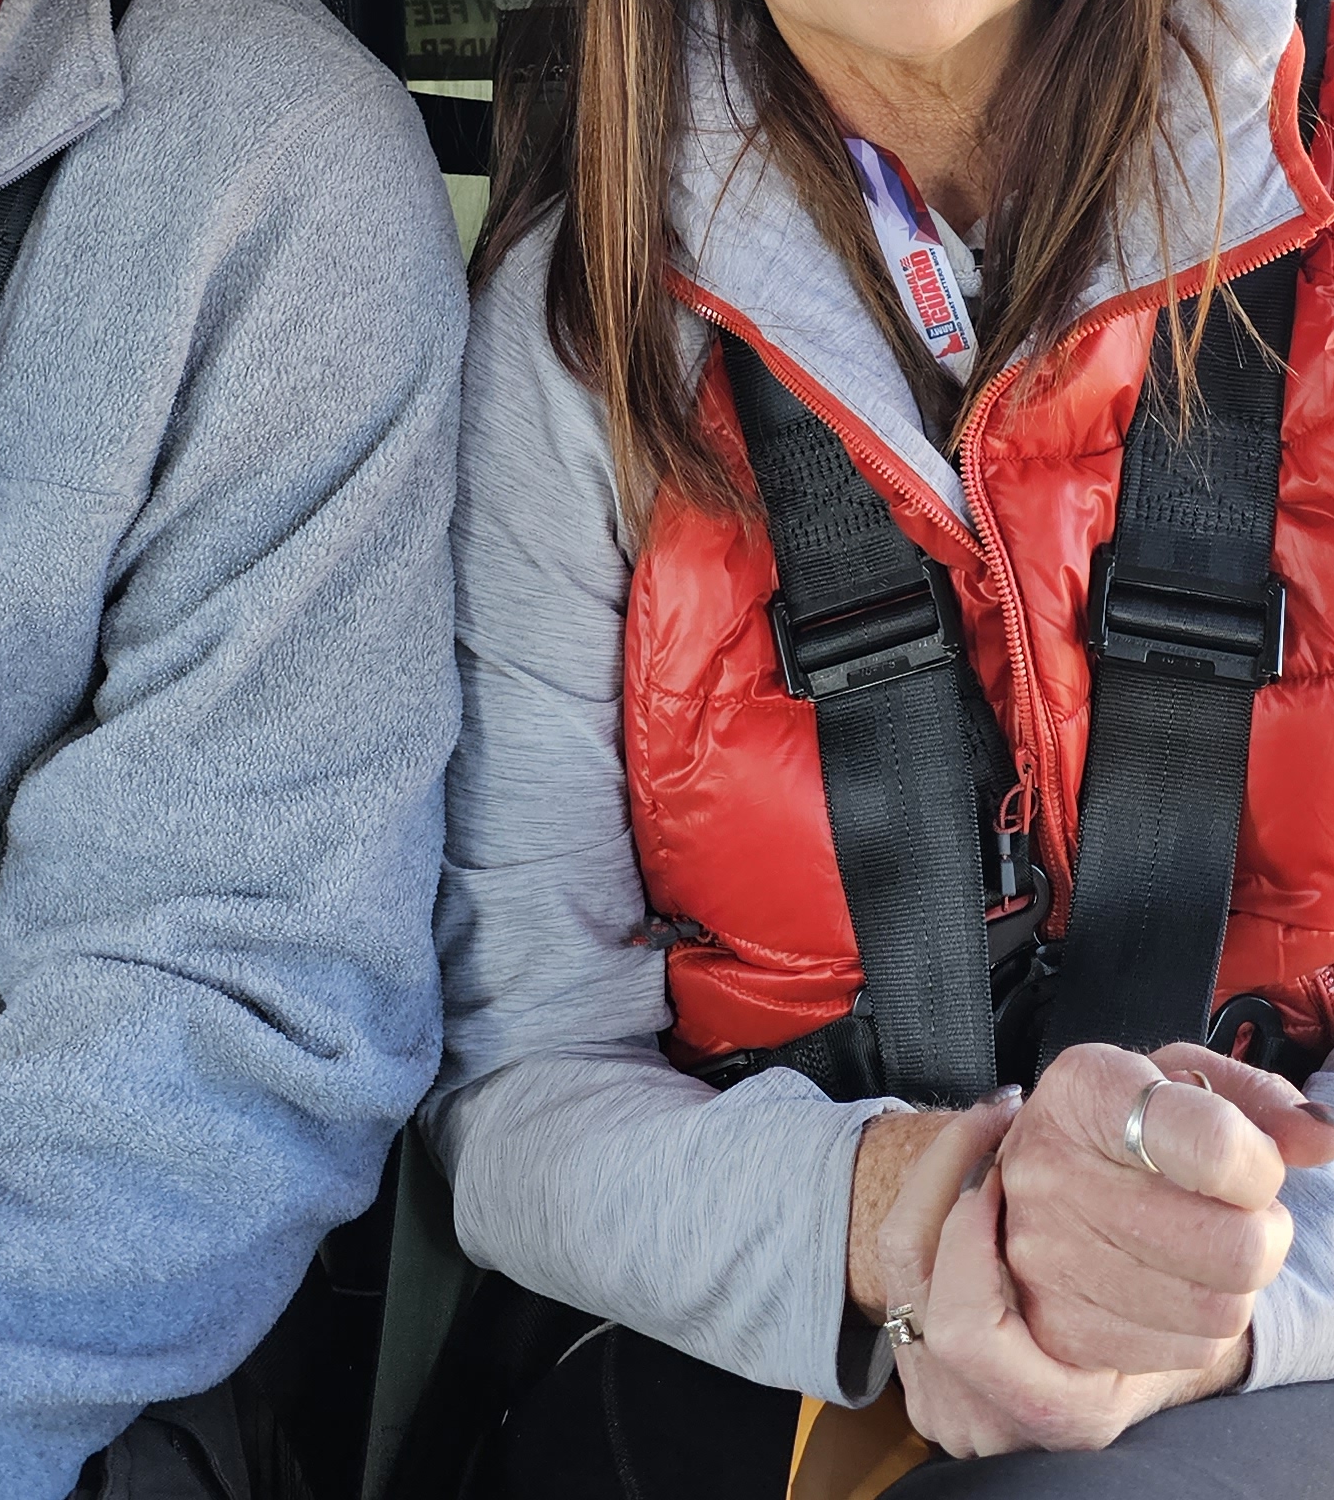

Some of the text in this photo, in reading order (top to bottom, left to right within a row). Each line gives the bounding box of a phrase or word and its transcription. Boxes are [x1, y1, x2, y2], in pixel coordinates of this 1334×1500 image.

[929, 248, 939, 266] MOST
[909, 250, 952, 324] GUARD
[937, 267, 953, 301] MATTERS
[905, 270, 934, 328] NATIONAL
[949, 301, 960, 321] WHAT
[929, 323, 956, 338] ARMY
